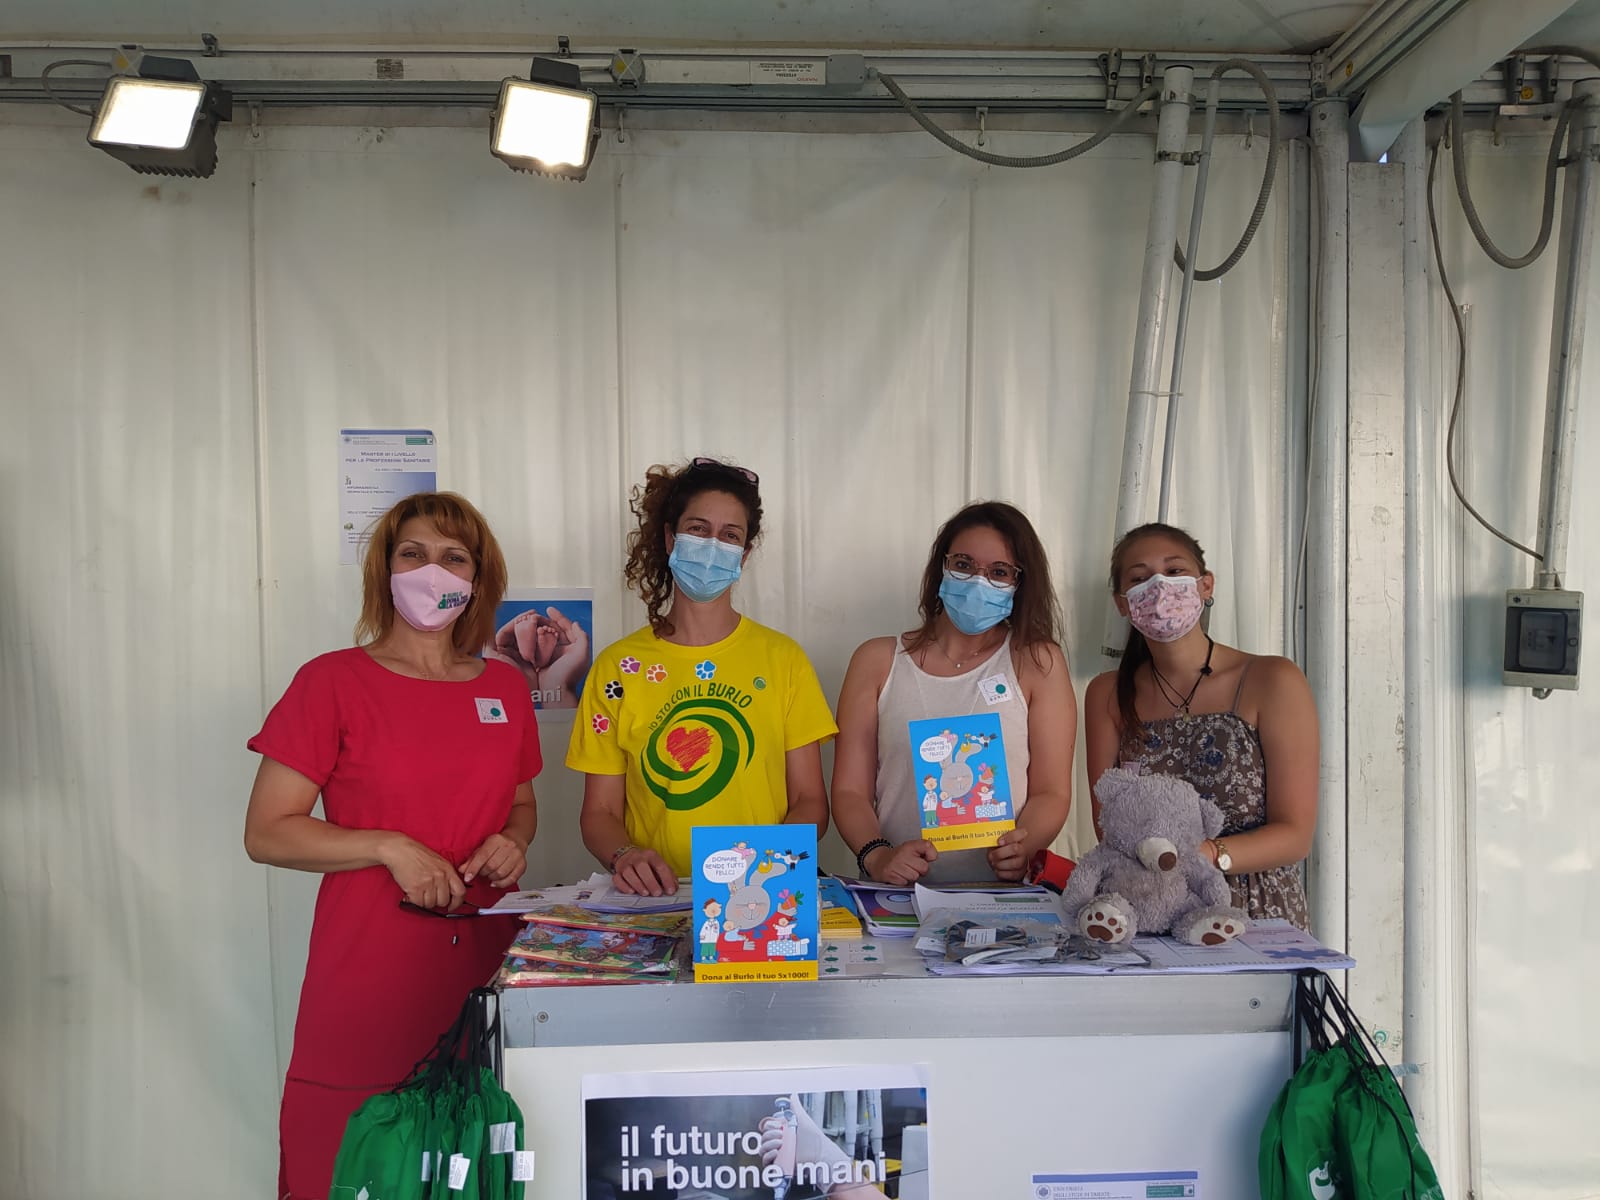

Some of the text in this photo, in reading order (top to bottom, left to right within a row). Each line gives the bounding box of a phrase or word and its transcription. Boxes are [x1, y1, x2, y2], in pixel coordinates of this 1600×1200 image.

[531, 686, 561, 703] ani
[656, 703, 671, 721] STO
[671, 685, 691, 704] CON
[694, 684, 703, 697] IL
[707, 682, 753, 709] BURLO
[756, 972, 761, 980] il
[621, 1125, 762, 1157] il futuro
[621, 1152, 886, 1191] in buone mani
